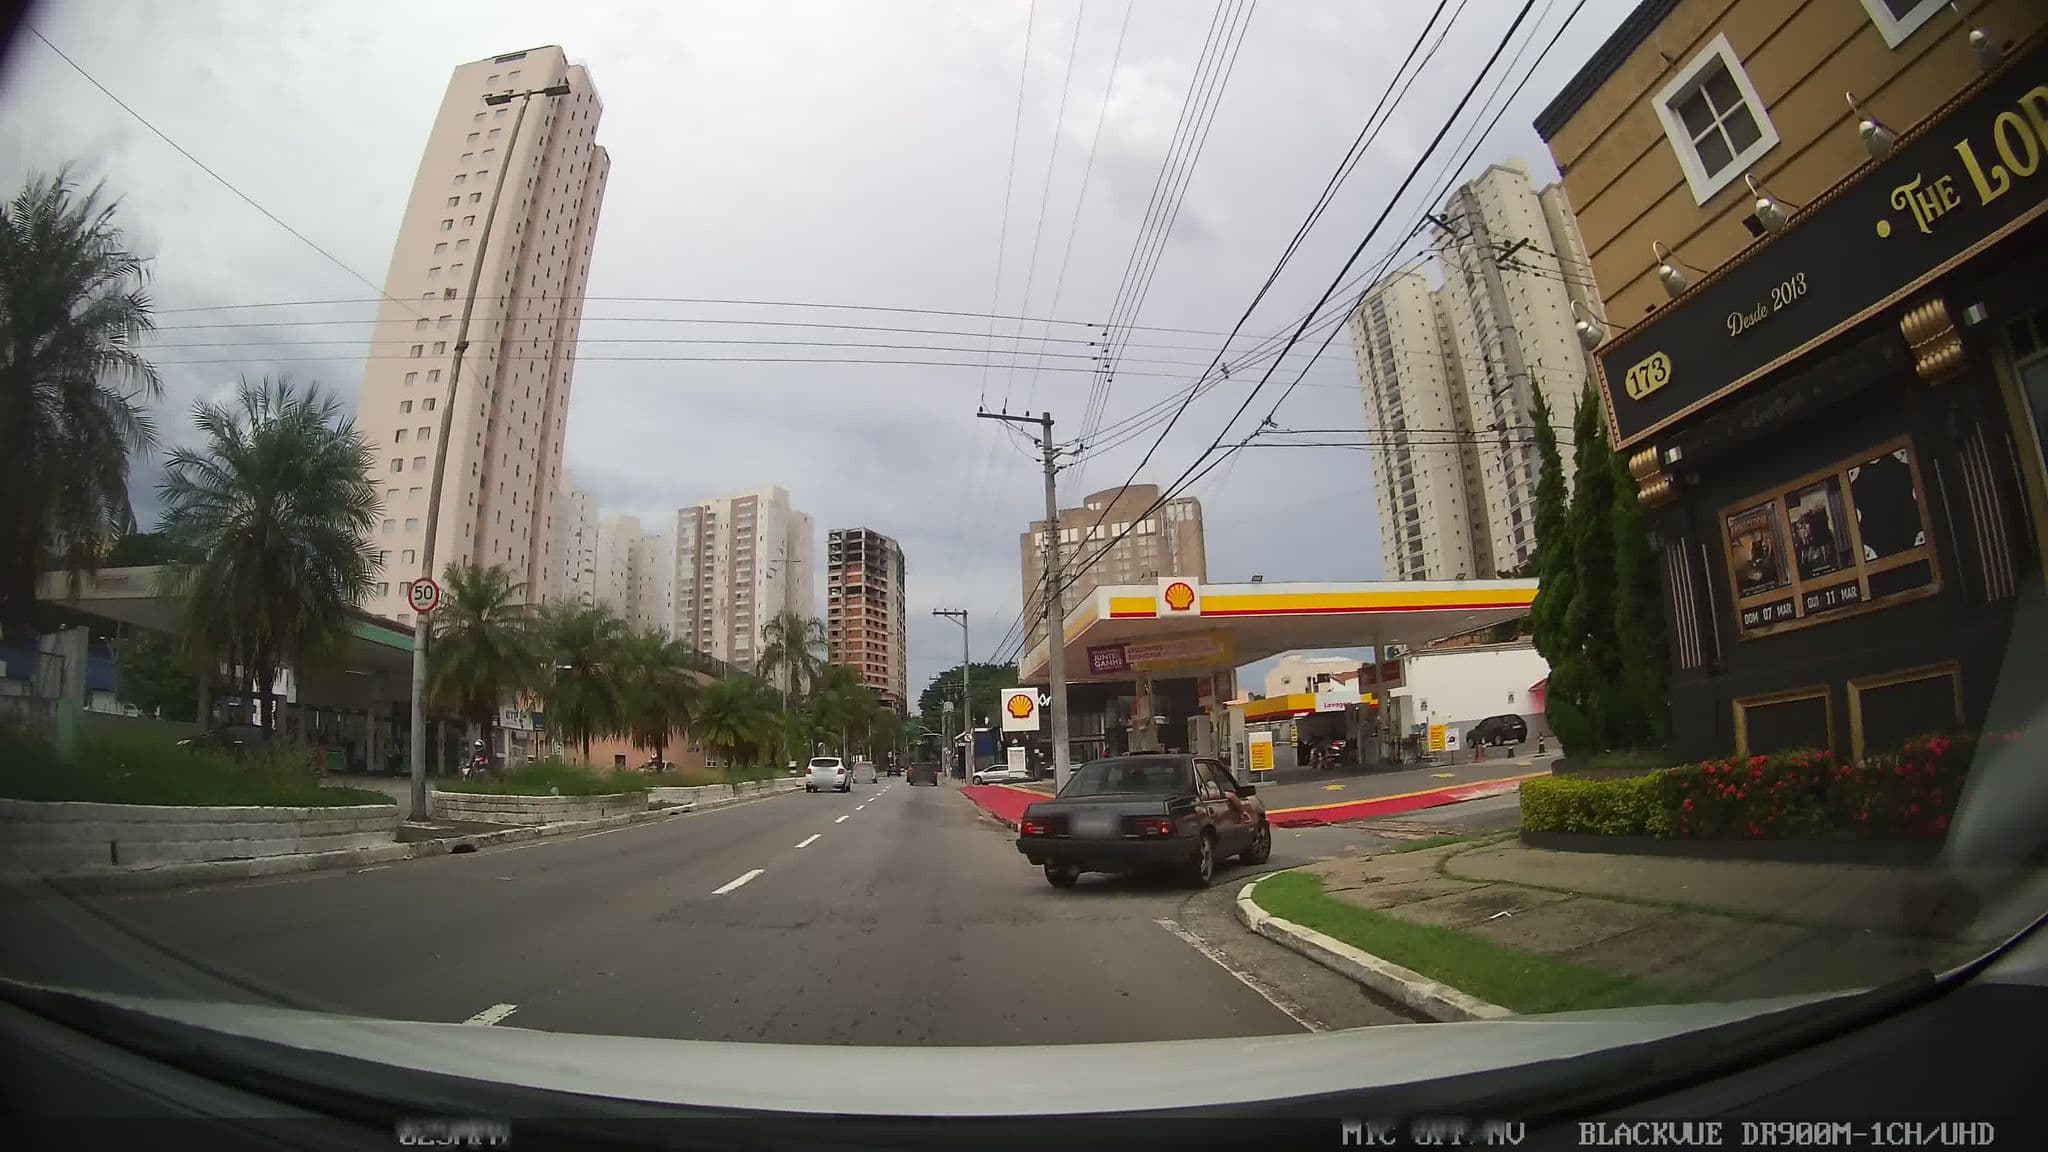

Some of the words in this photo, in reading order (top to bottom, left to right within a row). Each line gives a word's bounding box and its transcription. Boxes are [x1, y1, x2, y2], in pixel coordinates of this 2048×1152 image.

[1726, 302, 1769, 337] Desde
[1771, 271, 1808, 313] 2013
[1629, 356, 1667, 396] 173
[414, 585, 433, 600] 50
[1825, 590, 1836, 605] 11
[1841, 586, 1858, 600] MAR
[1744, 610, 1760, 625] DOM
[1763, 607, 1773, 621] 07
[1777, 603, 1793, 617] MAR
